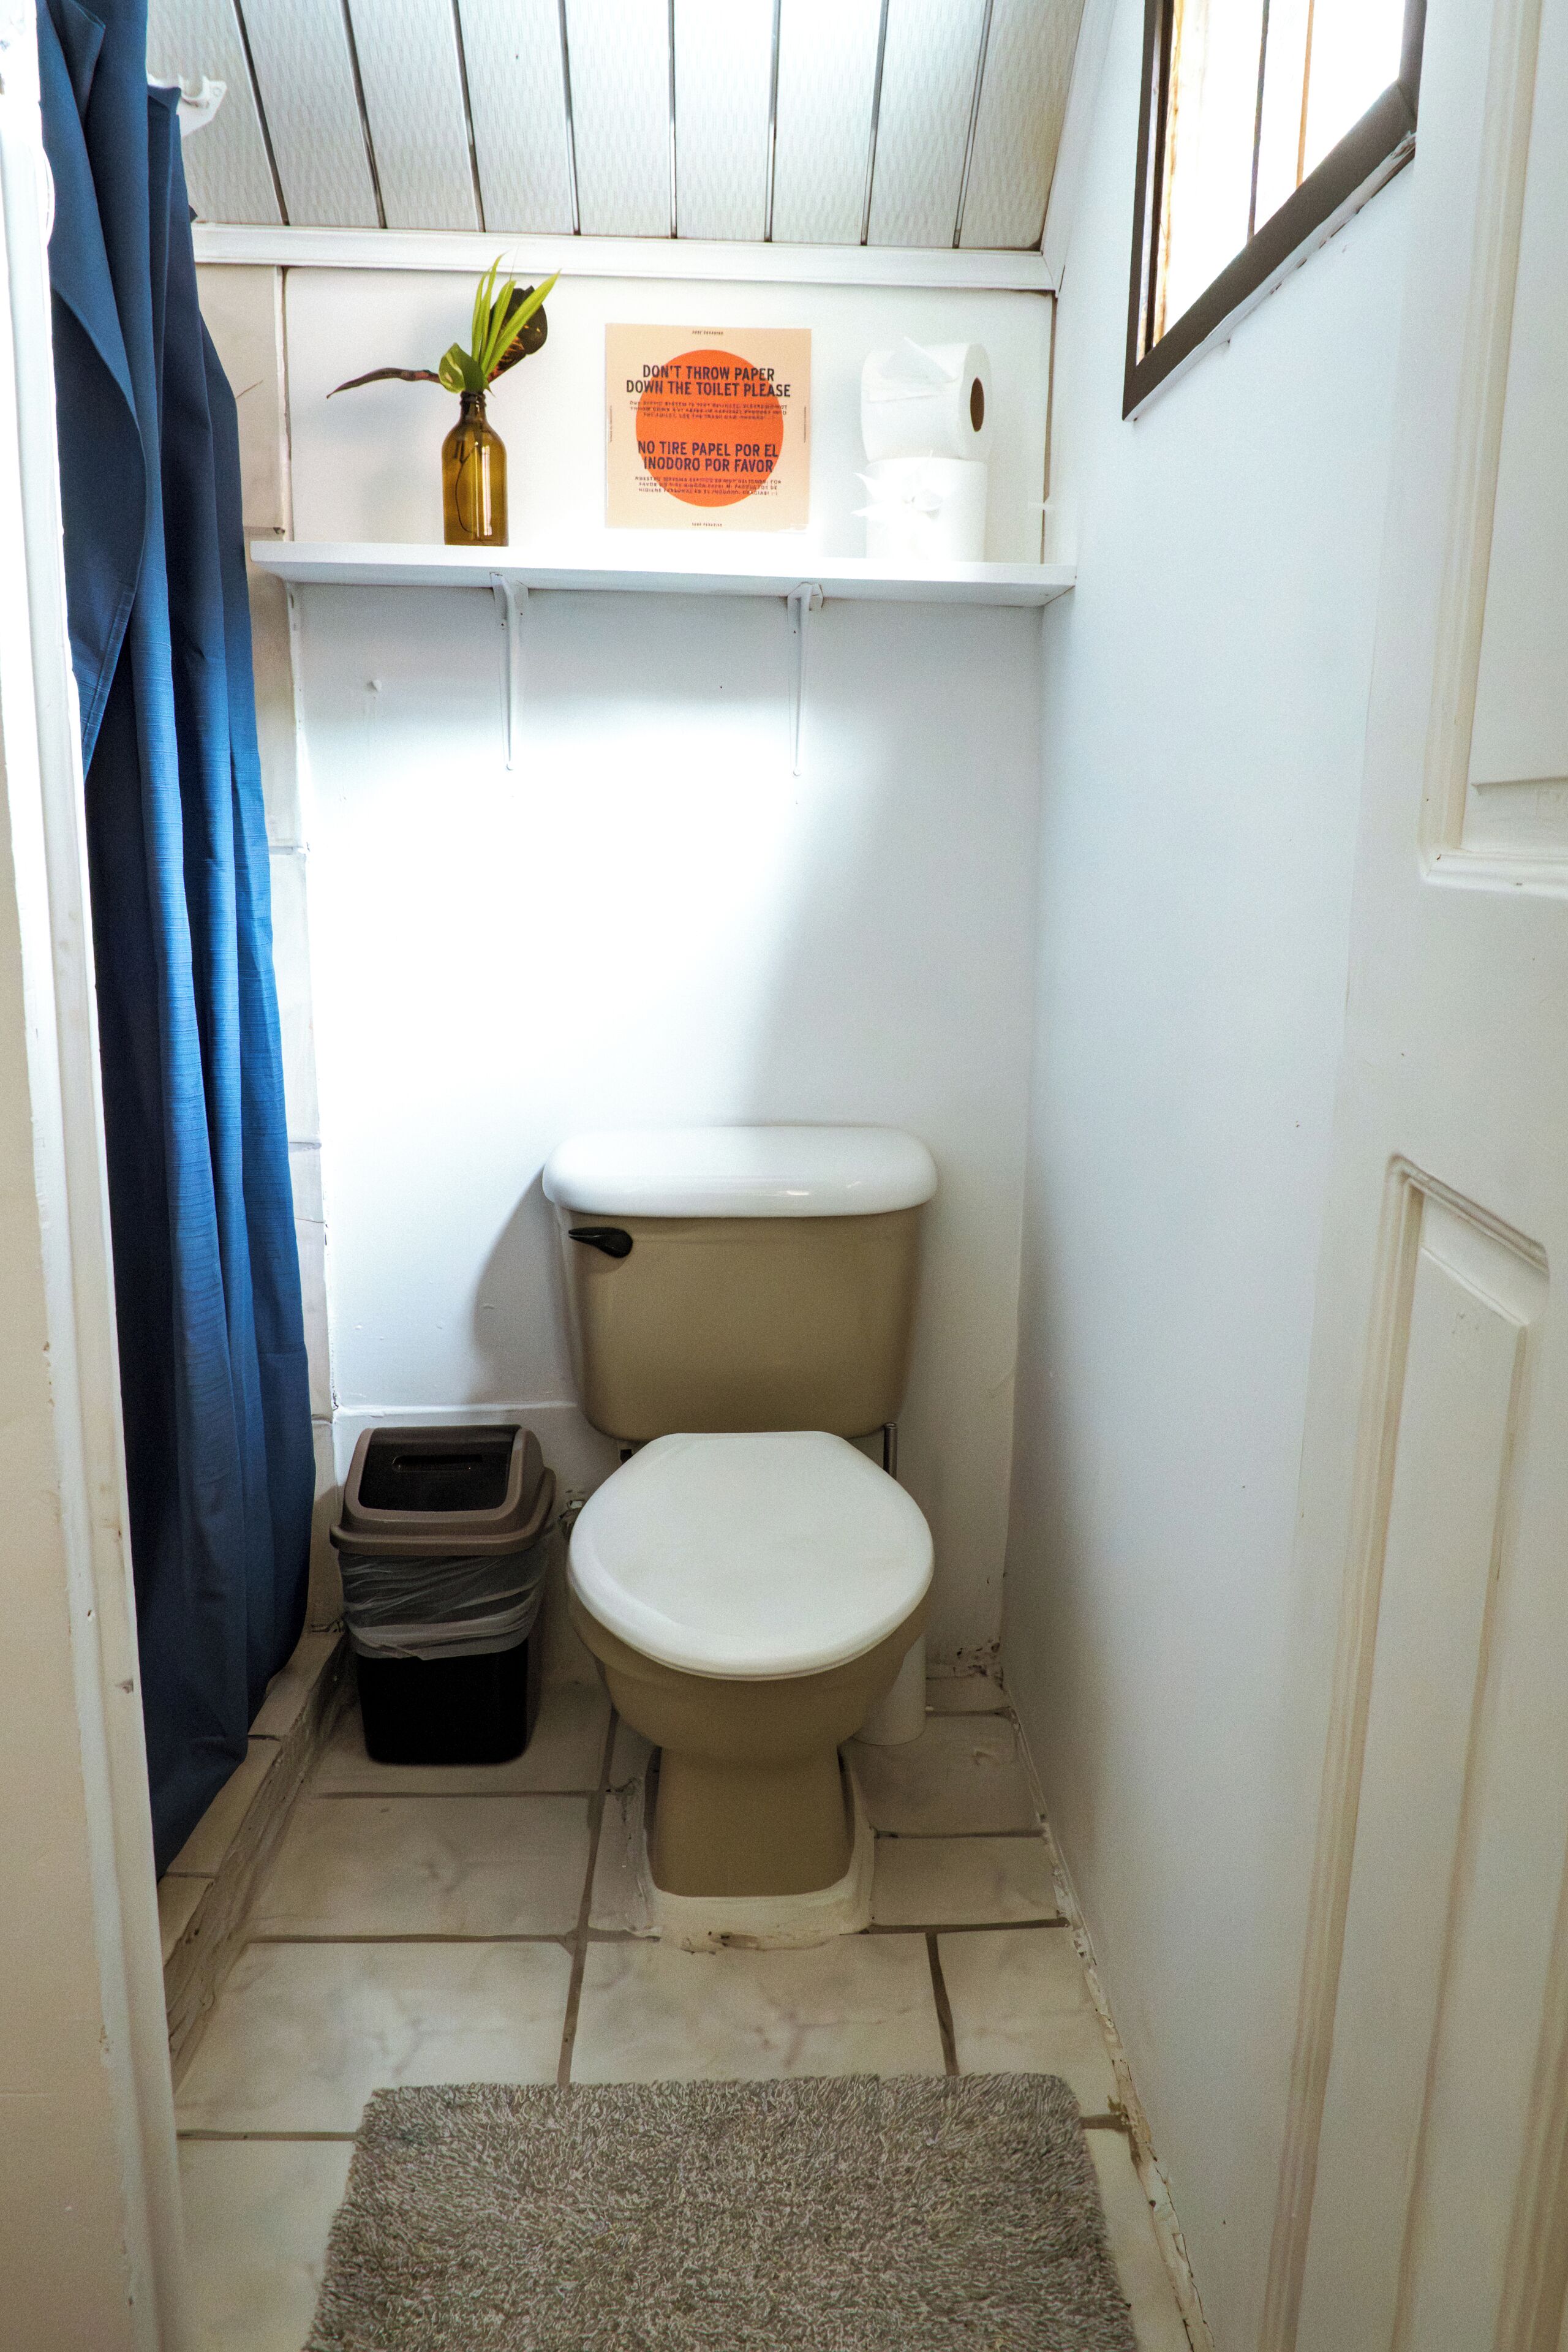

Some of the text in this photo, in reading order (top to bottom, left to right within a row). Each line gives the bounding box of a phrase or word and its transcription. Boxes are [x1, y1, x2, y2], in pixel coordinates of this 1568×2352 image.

[643, 364, 774, 381] DON'T THROW PAPER
[627, 380, 791, 397] DOWN THE TOILET PLEASE
[638, 440, 778, 457] NO TIRE PAPEL POR EL
[644, 456, 773, 473] INODORO POR FAVOR
